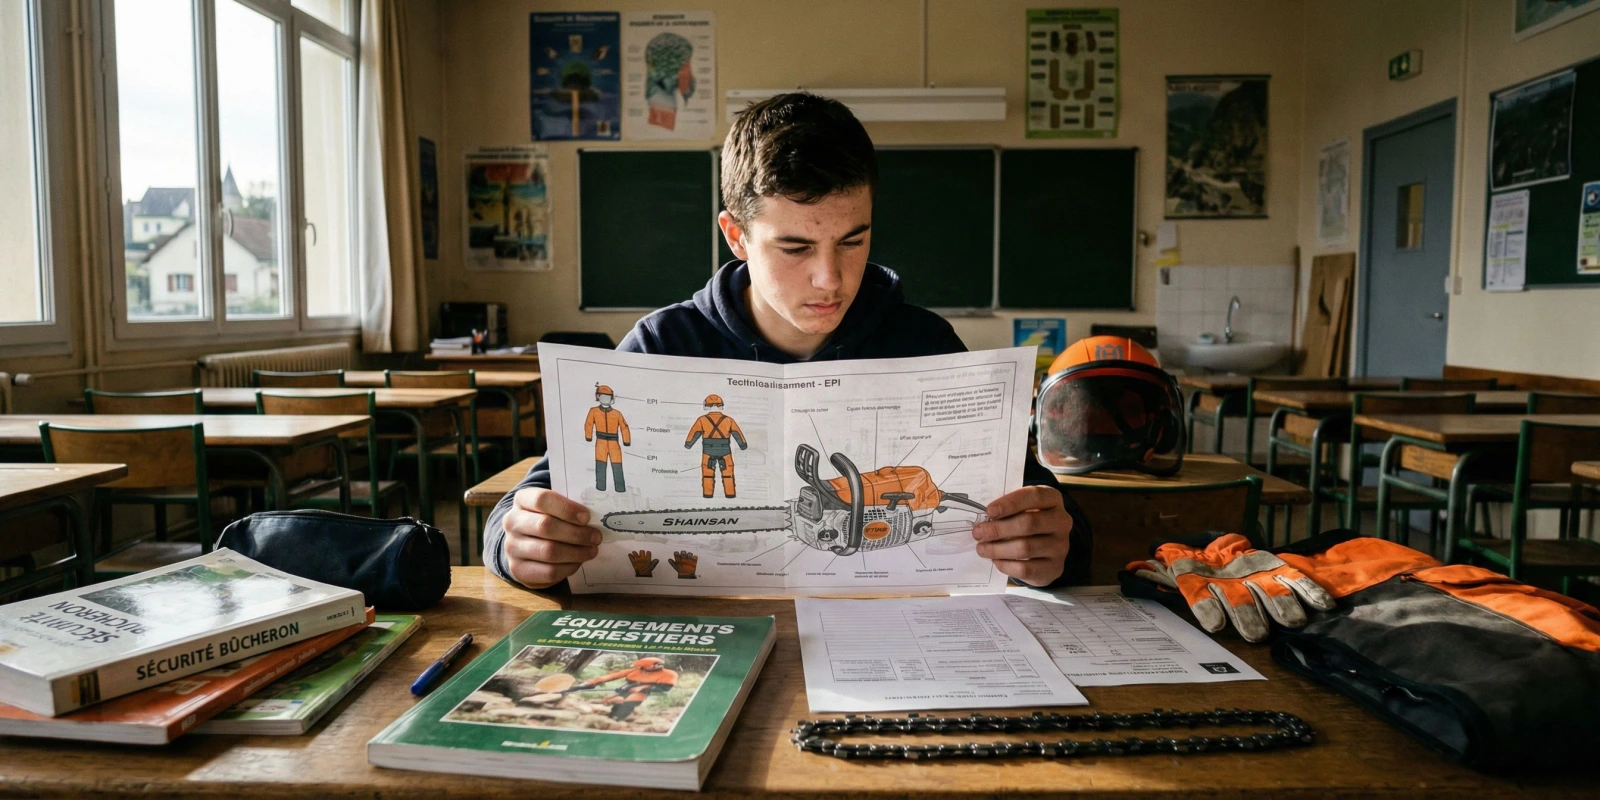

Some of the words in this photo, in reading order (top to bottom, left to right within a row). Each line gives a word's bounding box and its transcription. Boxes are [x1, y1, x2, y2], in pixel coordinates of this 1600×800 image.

[824, 378, 841, 388] EPI
[662, 517, 739, 526] SHAINSAN
[551, 614, 735, 635] ÉQUIPEMENTS
[555, 628, 716, 646] FORESTIERS
[135, 642, 214, 681] SÉCURITÉ
[219, 621, 300, 656] BÛCHERON
